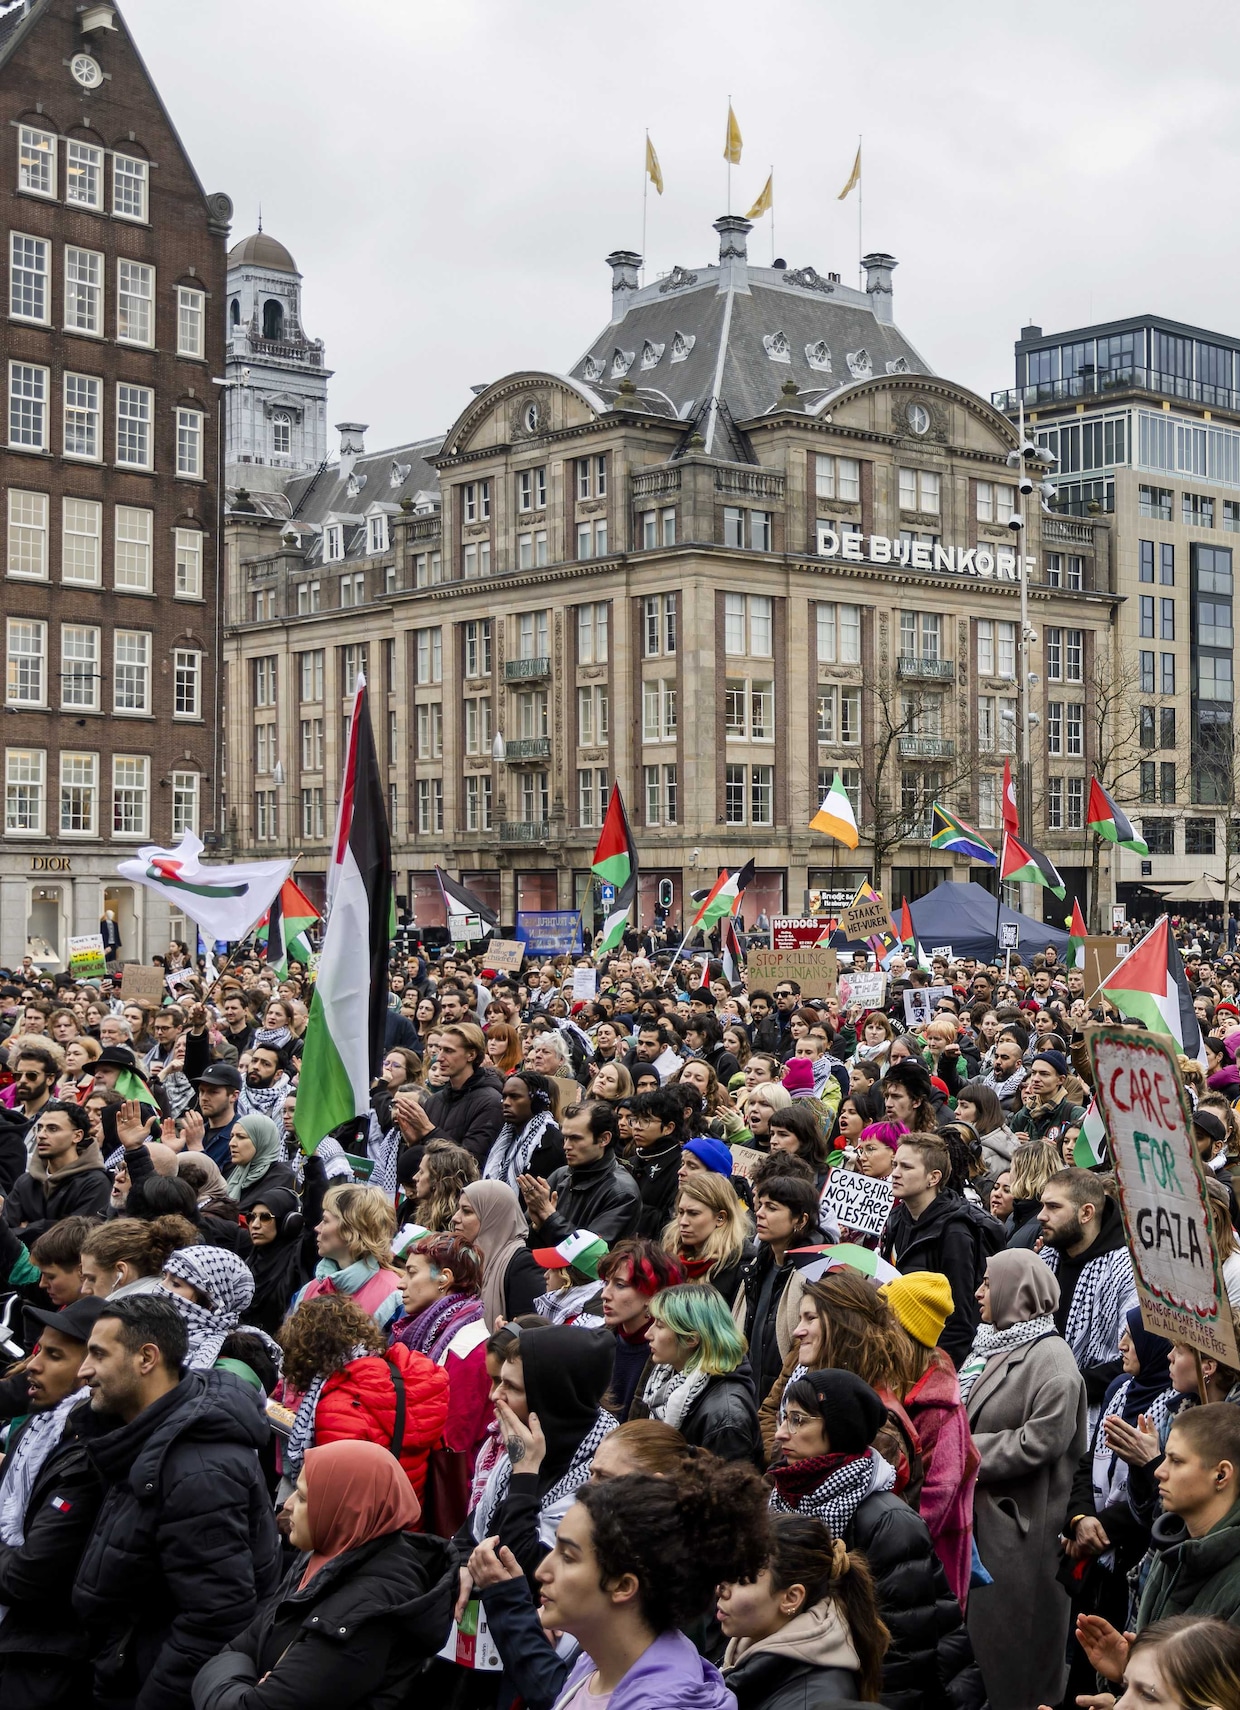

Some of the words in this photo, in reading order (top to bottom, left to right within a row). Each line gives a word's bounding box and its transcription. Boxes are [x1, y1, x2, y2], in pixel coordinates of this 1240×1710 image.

[817, 527, 864, 560] DE
[869, 534, 1037, 581] BIJENKORF
[31, 856, 71, 871] DIOR
[849, 904, 884, 921] STAAKT-
[451, 918, 465, 927] FREE
[774, 919, 818, 929] HOTDOGS
[847, 916, 888, 934] HET-VUREN
[451, 930, 481, 940] PALESTINE
[756, 953, 784, 967] STOP
[786, 953, 826, 965] KILLING
[128, 967, 152, 976] STOP
[849, 973, 875, 983] END
[855, 982, 879, 994] THE
[1109, 1066, 1177, 1131] CARE
[739, 1149, 757, 1160] FROM
[1132, 1130, 1185, 1195] FOR
[825, 1185, 860, 1206] NOW
[1136, 1206, 1205, 1268] GAZA
[1140, 1297, 1164, 1316] NONE
[1163, 1306, 1172, 1317] OF
[1171, 1311, 1182, 1322] US
[1182, 1313, 1194, 1328] ARE
[1194, 1321, 1216, 1339] FREE
[1146, 1314, 1161, 1327] TILL
[1163, 1318, 1178, 1333] ALL
[1178, 1326, 1188, 1337] OF
[1188, 1330, 1198, 1342] US
[1197, 1335, 1211, 1349] ARE
[1210, 1339, 1227, 1356] FREE
